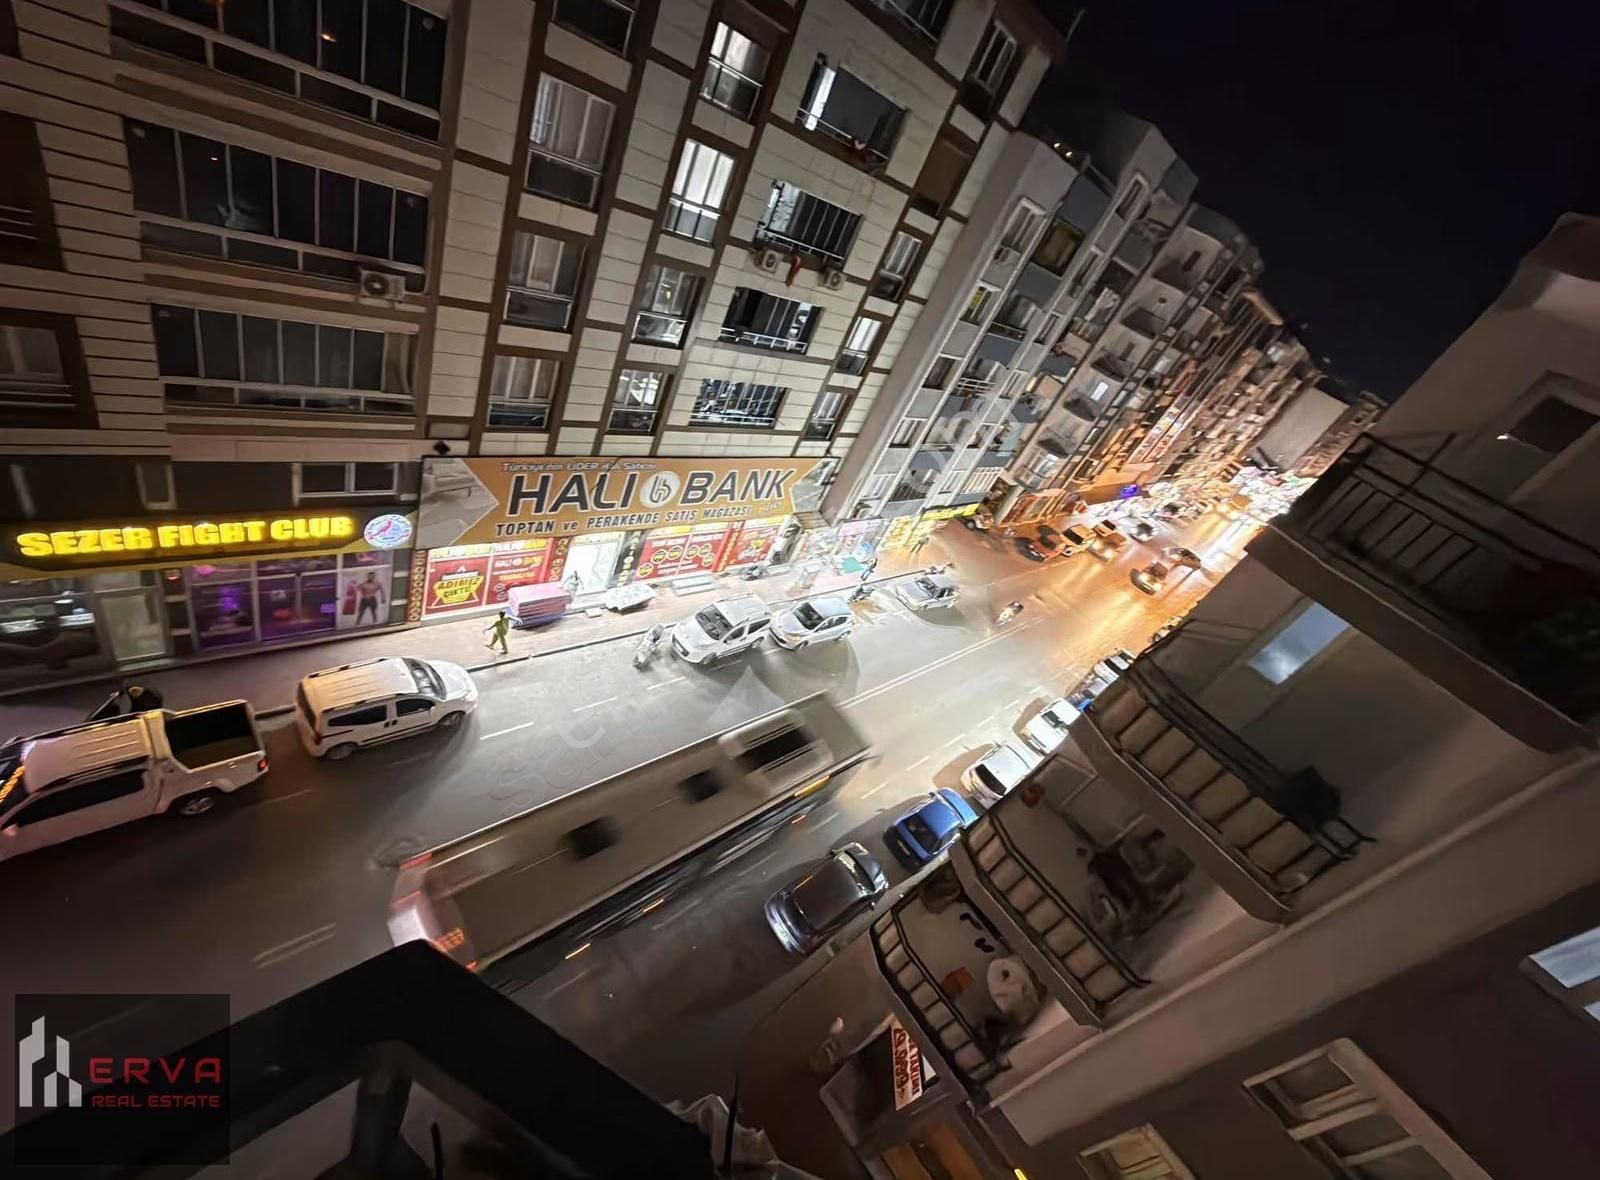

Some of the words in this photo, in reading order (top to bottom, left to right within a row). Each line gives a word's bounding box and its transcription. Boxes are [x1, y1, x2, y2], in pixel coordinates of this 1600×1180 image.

[506, 471, 640, 517] HALI
[680, 468, 796, 505] BANK
[17, 526, 153, 556] SEZER
[157, 520, 266, 548] FIGHT
[270, 516, 353, 541] CLUB
[496, 521, 554, 536] TOPTAN
[563, 521, 578, 531] ve
[587, 512, 659, 529] PERAKENDE
